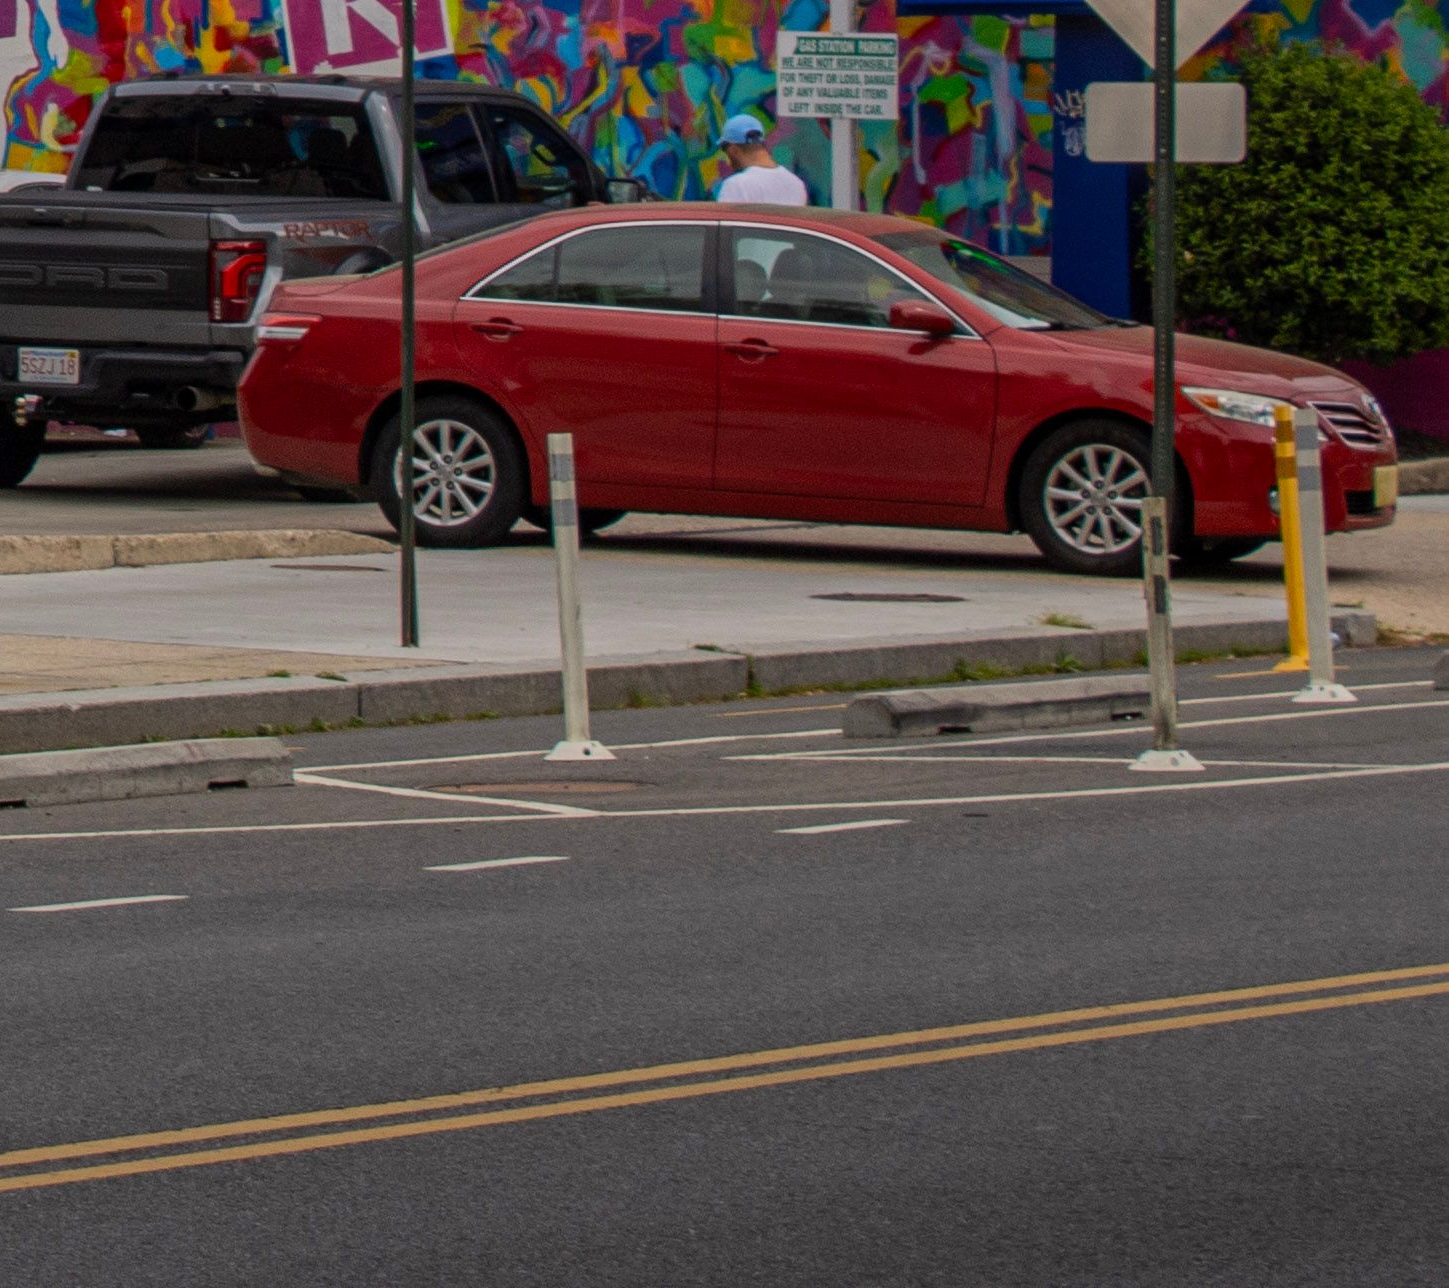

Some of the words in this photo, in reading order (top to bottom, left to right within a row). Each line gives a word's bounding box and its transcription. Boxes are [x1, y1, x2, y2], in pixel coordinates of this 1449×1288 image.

[798, 39, 817, 54] GAS
[819, 39, 855, 54] STATION
[859, 40, 896, 55] PARKING
[782, 57, 794, 69] WE
[796, 57, 813, 69] ARE
[816, 58, 833, 70] NOT
[780, 73, 796, 83] FOR
[798, 73, 823, 83] THEFT
[826, 73, 837, 83] OR
[864, 74, 895, 85] DAMAGE
[783, 86, 793, 97] OF
[796, 87, 813, 97] ANY
[817, 88, 860, 98] VALUABLE
[862, 89, 888, 99] ITEMS
[788, 103, 809, 113] LEFT
[814, 103, 843, 113] INSIDE
[845, 104, 862, 114] THE
[283, 221, 372, 243] RAPTOR
[59, 358, 76, 376] 18
